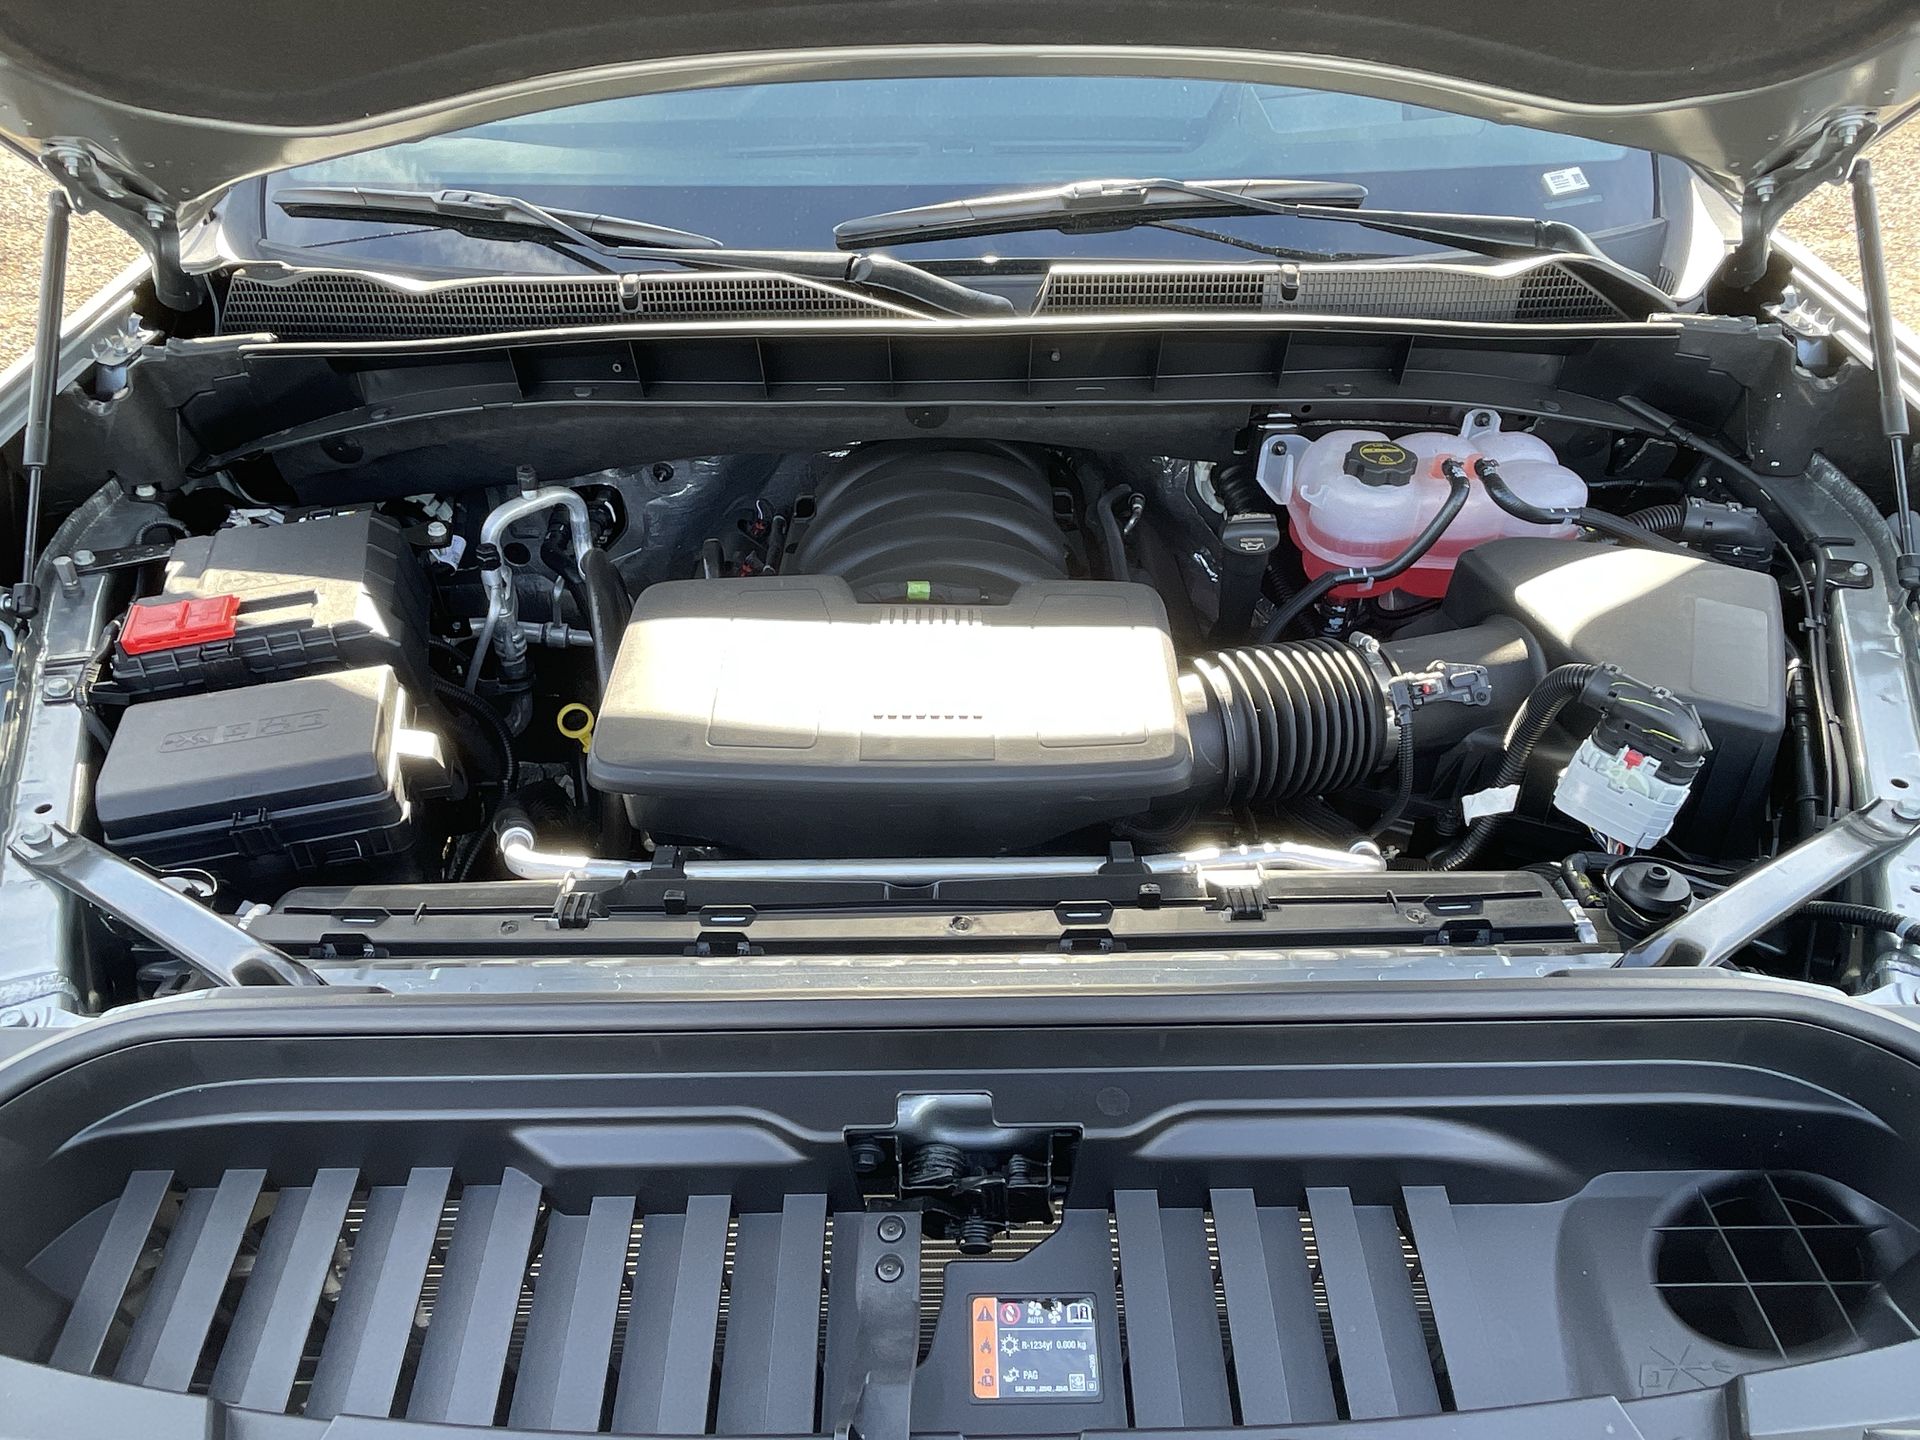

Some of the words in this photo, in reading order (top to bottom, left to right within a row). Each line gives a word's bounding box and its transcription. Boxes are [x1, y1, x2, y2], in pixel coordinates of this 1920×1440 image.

[1027, 1316, 1044, 1324] AUTO
[1077, 1340, 1087, 1351] kg
[1023, 1370, 1039, 1380] PAG
